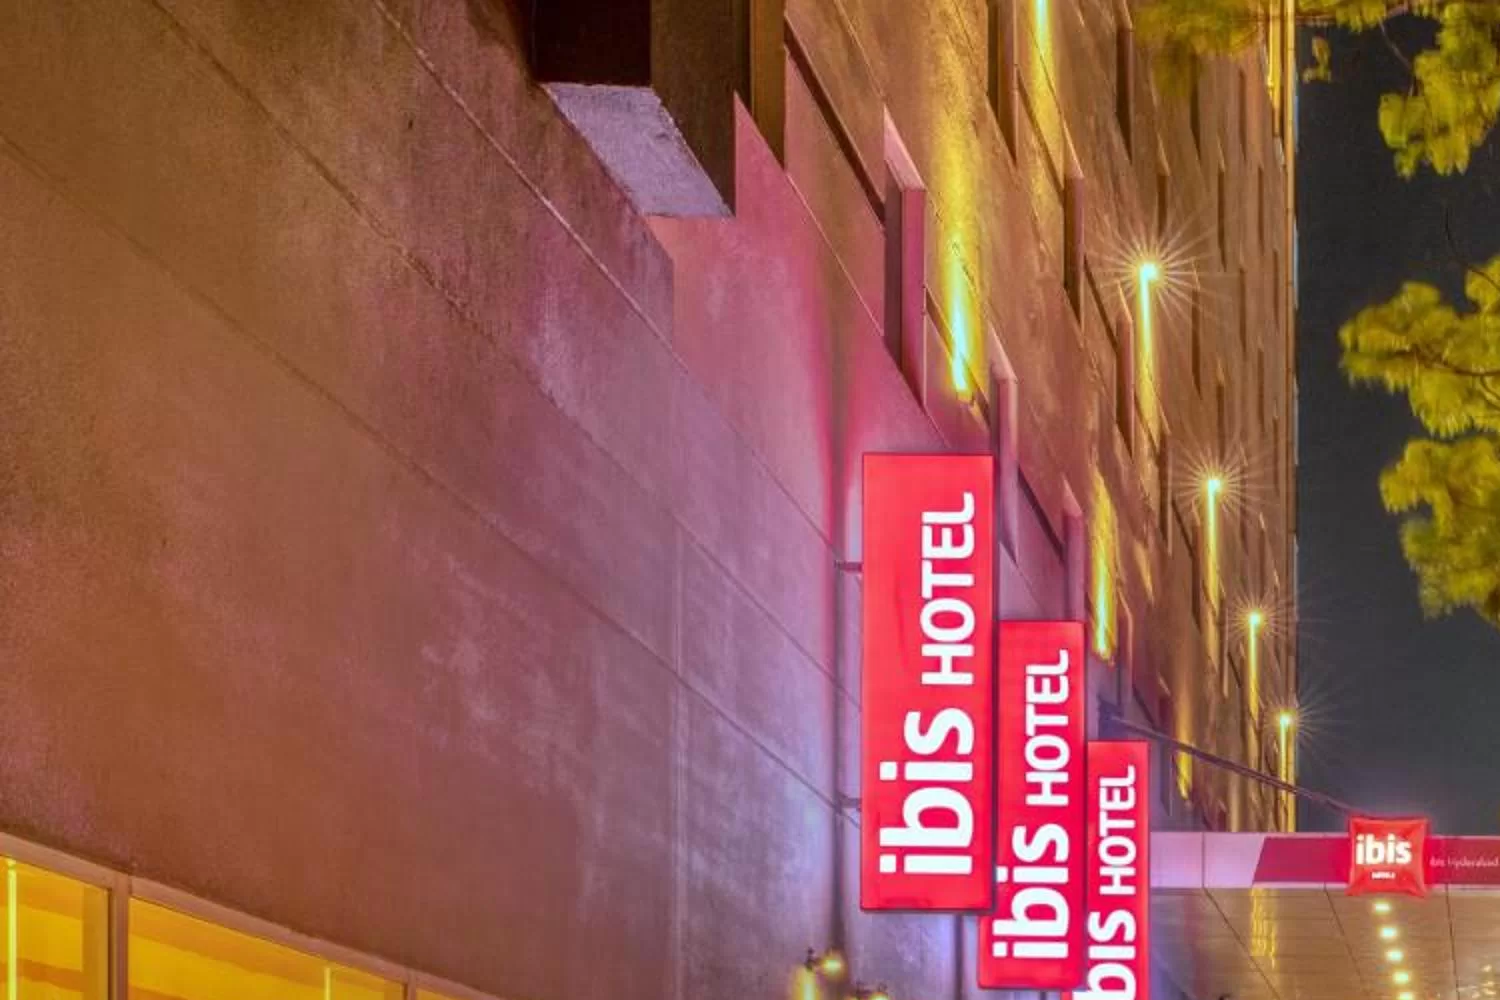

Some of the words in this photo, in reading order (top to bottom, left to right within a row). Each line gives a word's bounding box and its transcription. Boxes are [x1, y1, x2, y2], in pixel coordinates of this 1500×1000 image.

[919, 491, 975, 685] HOTEL
[879, 707, 975, 875] ibis
[1025, 648, 1069, 806] HOTEL
[993, 823, 1070, 959] ibis
[1098, 765, 1136, 895] HOTEL
[1355, 832, 1413, 865] ibis
